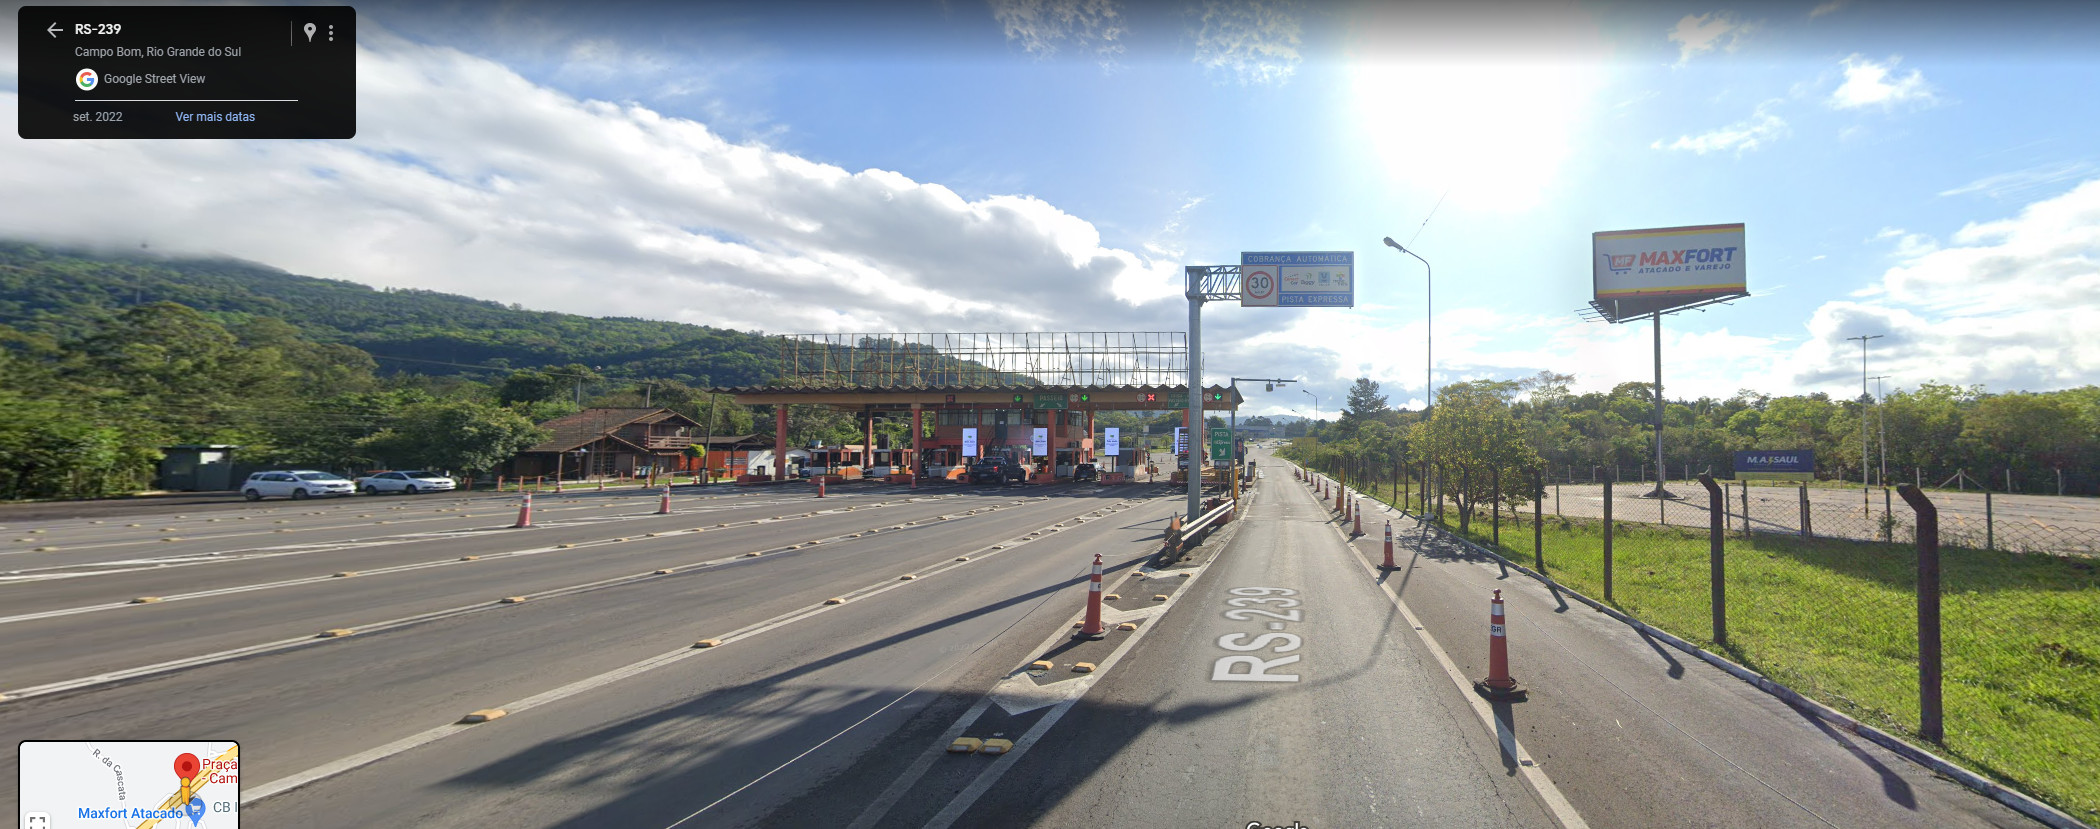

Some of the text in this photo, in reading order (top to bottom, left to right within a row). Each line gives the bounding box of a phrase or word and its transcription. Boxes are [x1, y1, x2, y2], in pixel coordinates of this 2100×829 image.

[1639, 247, 1737, 266] MAXFORT
[1638, 266, 1681, 274] ATACADO
[1694, 263, 1731, 271] VAREJO
[1251, 277, 1269, 289] 30
[1281, 295, 1348, 303] PISTA EXPRESSA
